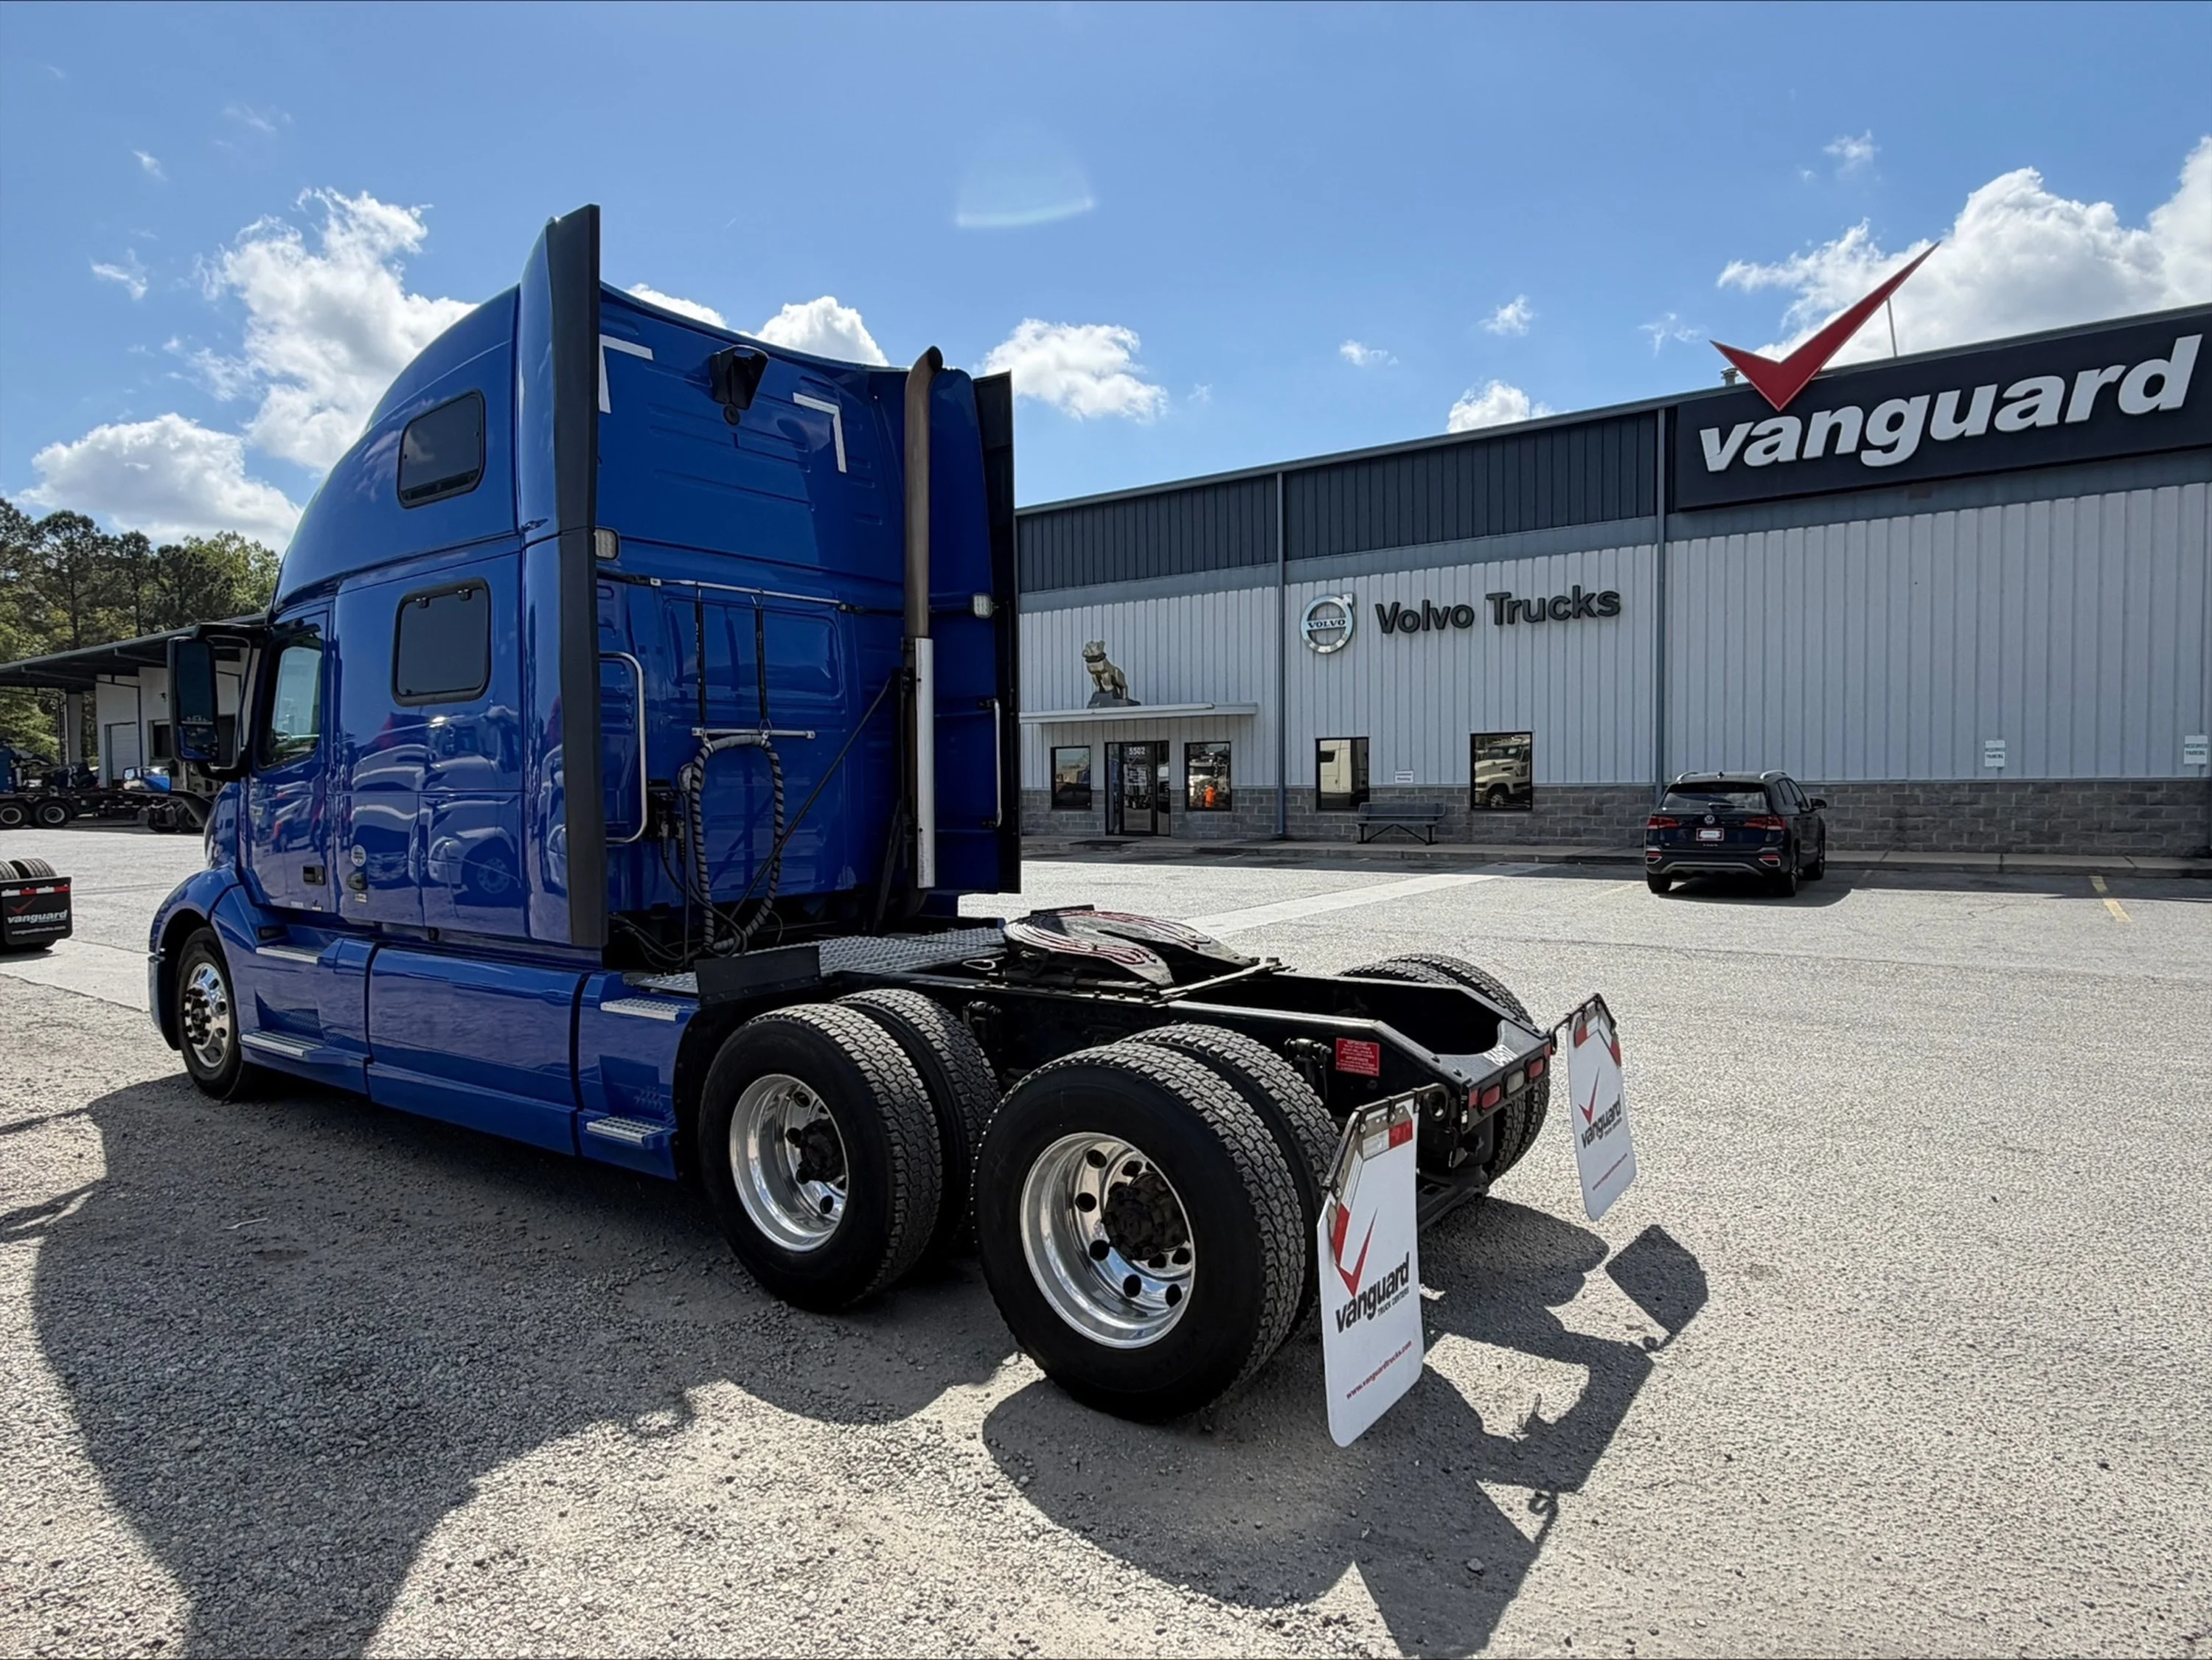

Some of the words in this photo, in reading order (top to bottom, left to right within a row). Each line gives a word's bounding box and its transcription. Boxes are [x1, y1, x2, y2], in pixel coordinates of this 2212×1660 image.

[1699, 333, 2203, 472] vanguard
[1307, 618, 1346, 629] VOLVO
[1375, 599, 1475, 635] Volvo
[1486, 585, 1621, 625] Trucks
[7, 909, 68, 924] vanguard
[1581, 1093, 1621, 1149] vanguard
[1335, 1251, 1410, 1333] vanguard
